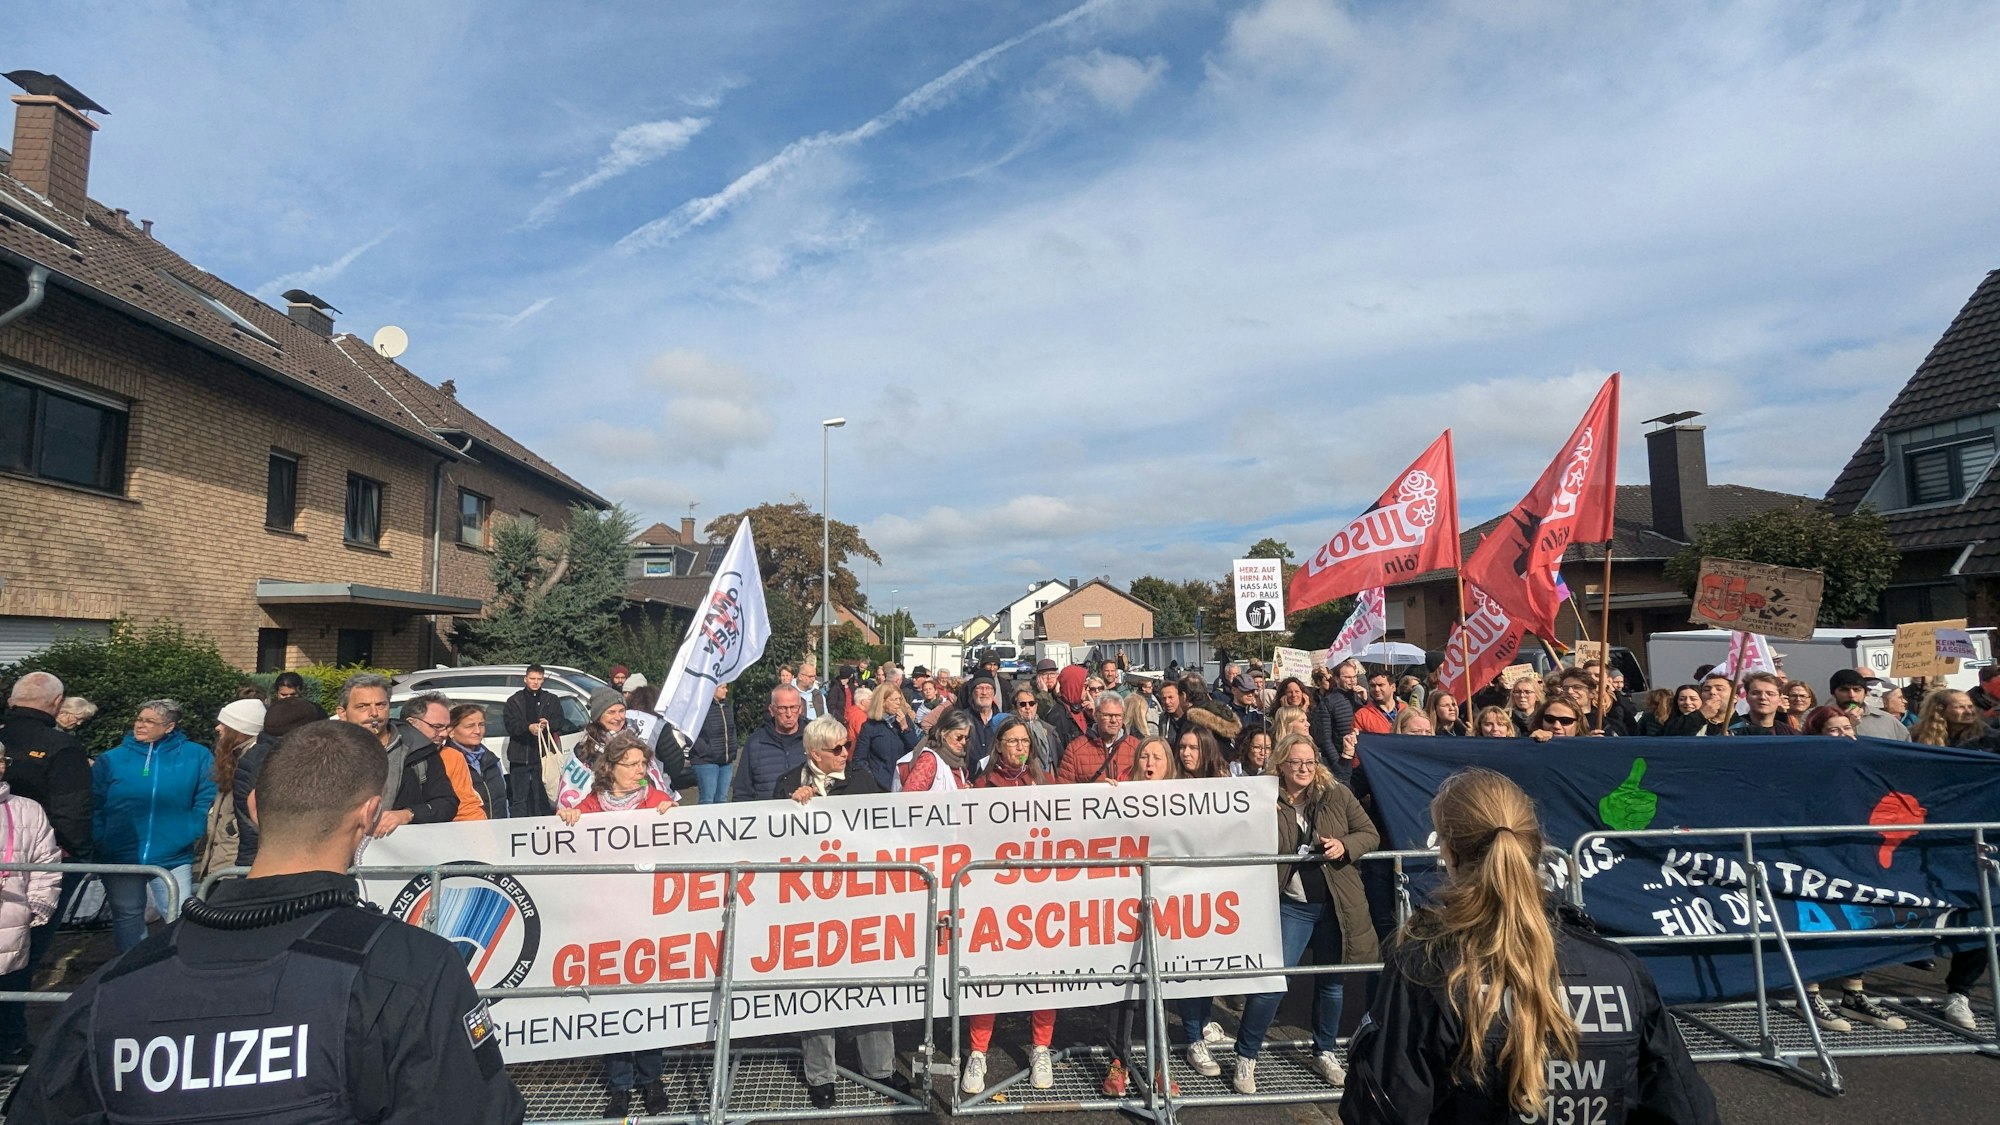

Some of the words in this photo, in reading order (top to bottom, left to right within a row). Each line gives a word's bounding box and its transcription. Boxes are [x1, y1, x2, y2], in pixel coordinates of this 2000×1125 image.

[1259, 591, 1280, 599] RAUS
[1873, 653, 1889, 667] 100
[1935, 640, 1956, 648] KEIN
[511, 826, 577, 857] FÜR
[587, 816, 758, 852] TOLERANZ
[768, 811, 840, 838] UND
[842, 803, 979, 832] VIELFALT
[988, 797, 1071, 824] OHNE
[1082, 790, 1251, 821] RASSISMUS
[652, 861, 756, 916] DER
[779, 839, 972, 904] KÖLNER
[994, 827, 1150, 885] SÜDEN
[499, 876, 535, 919] GEFAHR
[1652, 896, 1727, 935] FÜR
[552, 930, 726, 989] GEGEN
[750, 913, 916, 973] JEDEN
[937, 890, 1241, 956] FASCHISMUS
[731, 984, 928, 1022] DEMOKRATIE
[114, 1023, 309, 1093] POLIZEI
